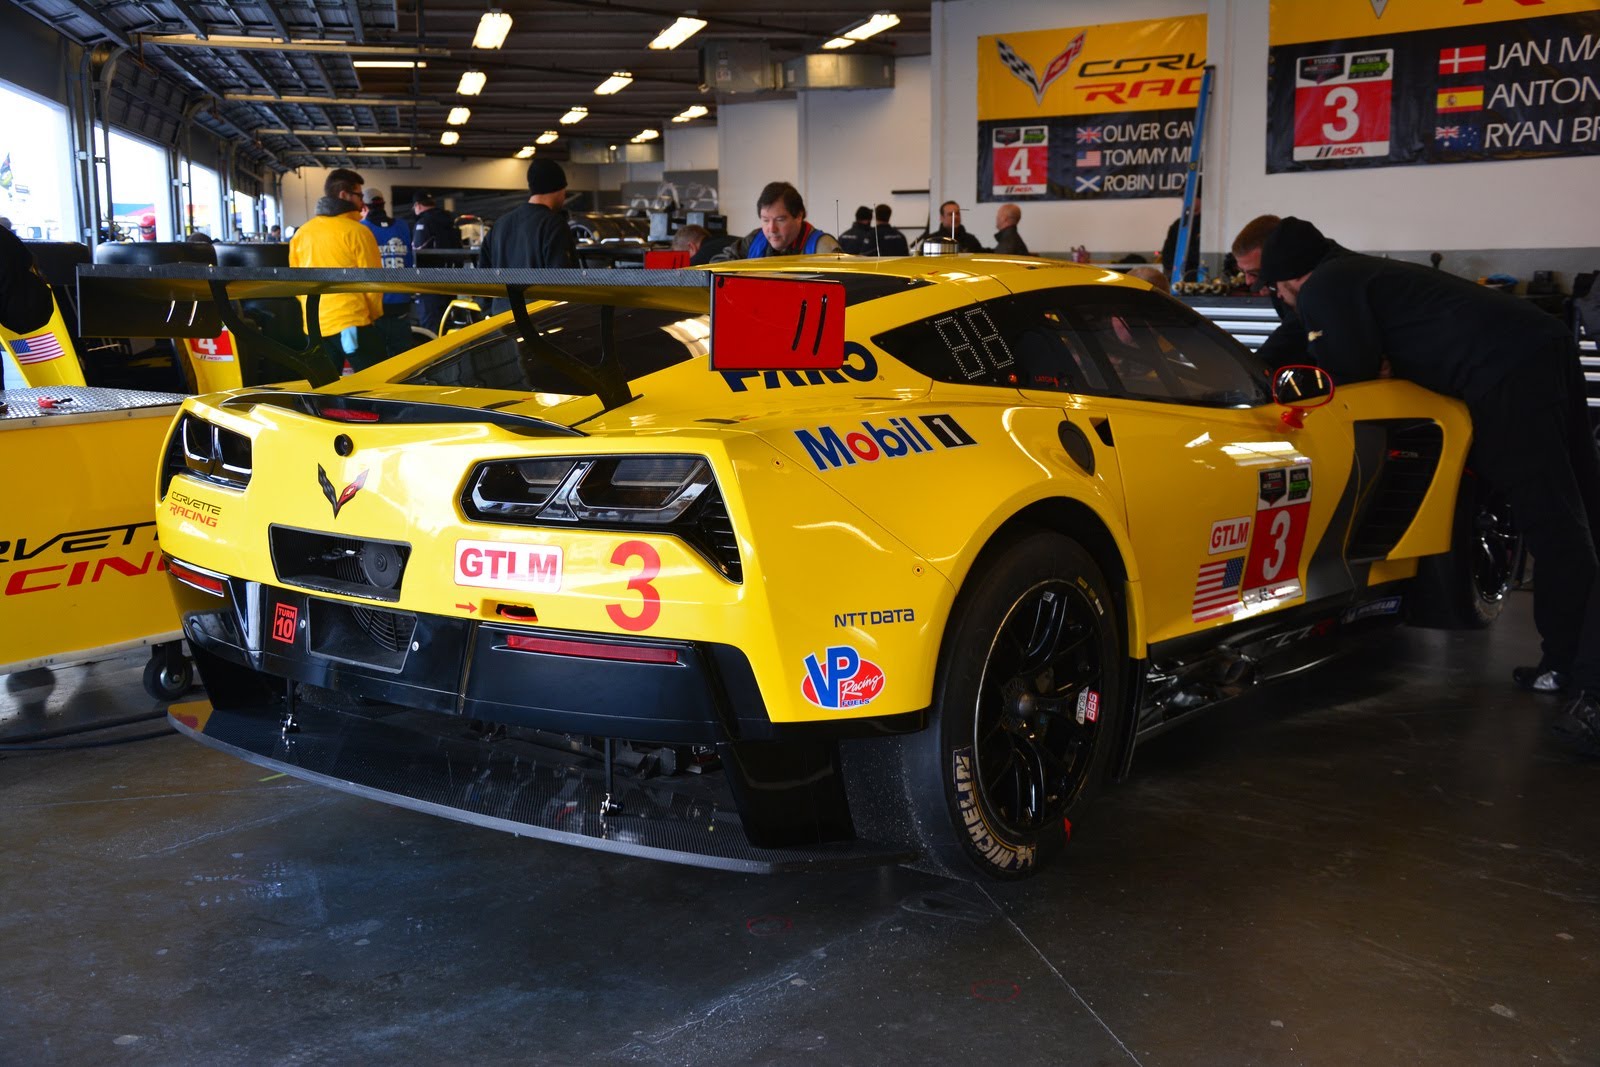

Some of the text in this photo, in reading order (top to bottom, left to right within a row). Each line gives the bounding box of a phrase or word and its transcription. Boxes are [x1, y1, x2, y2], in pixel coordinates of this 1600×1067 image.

[1489, 39, 1551, 70] JAN
[1487, 76, 1600, 109] ANTON
[1322, 86, 1360, 142] 3
[1103, 123, 1160, 143] OLIVER
[1484, 119, 1563, 148] RYAN
[1008, 148, 1032, 184] 4
[1103, 147, 1168, 166] TOMMY
[1103, 173, 1188, 191] ROBIN LID
[198, 338, 217, 355] 4
[795, 418, 933, 470] Mobil
[170, 502, 218, 528] RACING
[171, 491, 222, 516] CORVETTE
[1211, 521, 1250, 549] GTLM
[1262, 510, 1291, 580] 3
[459, 540, 661, 632] GTLM 3
[278, 607, 295, 619] TURN
[834, 612, 868, 628] NTT
[276, 617, 293, 638] 10
[803, 645, 860, 709] VP
[841, 675, 884, 699] Racing
[841, 698, 870, 707] FUELS
[1086, 692, 1098, 721] BBS
[955, 755, 1016, 869] MICHELIN
